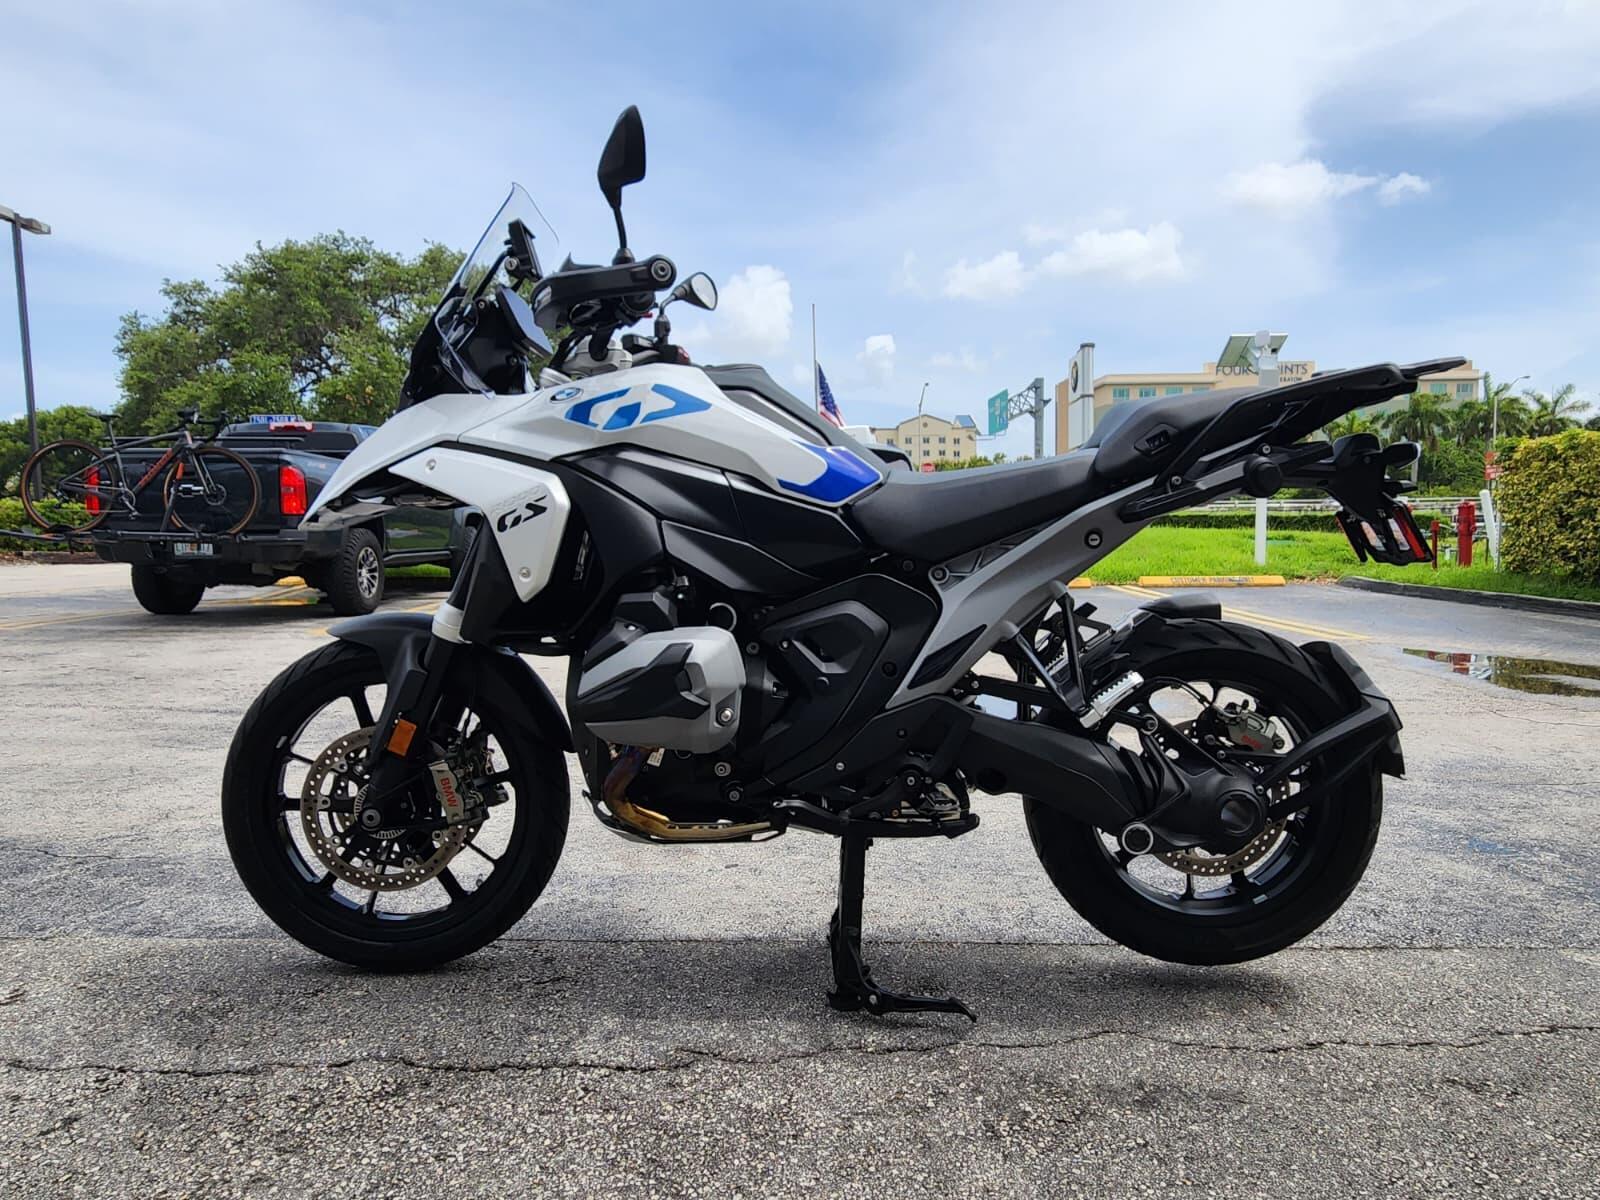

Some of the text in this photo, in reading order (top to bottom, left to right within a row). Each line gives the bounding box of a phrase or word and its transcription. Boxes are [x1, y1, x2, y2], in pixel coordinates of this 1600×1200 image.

[1216, 363, 1308, 376] FOUR INTS
[496, 494, 548, 533] GS
[440, 777, 458, 808] BMW
